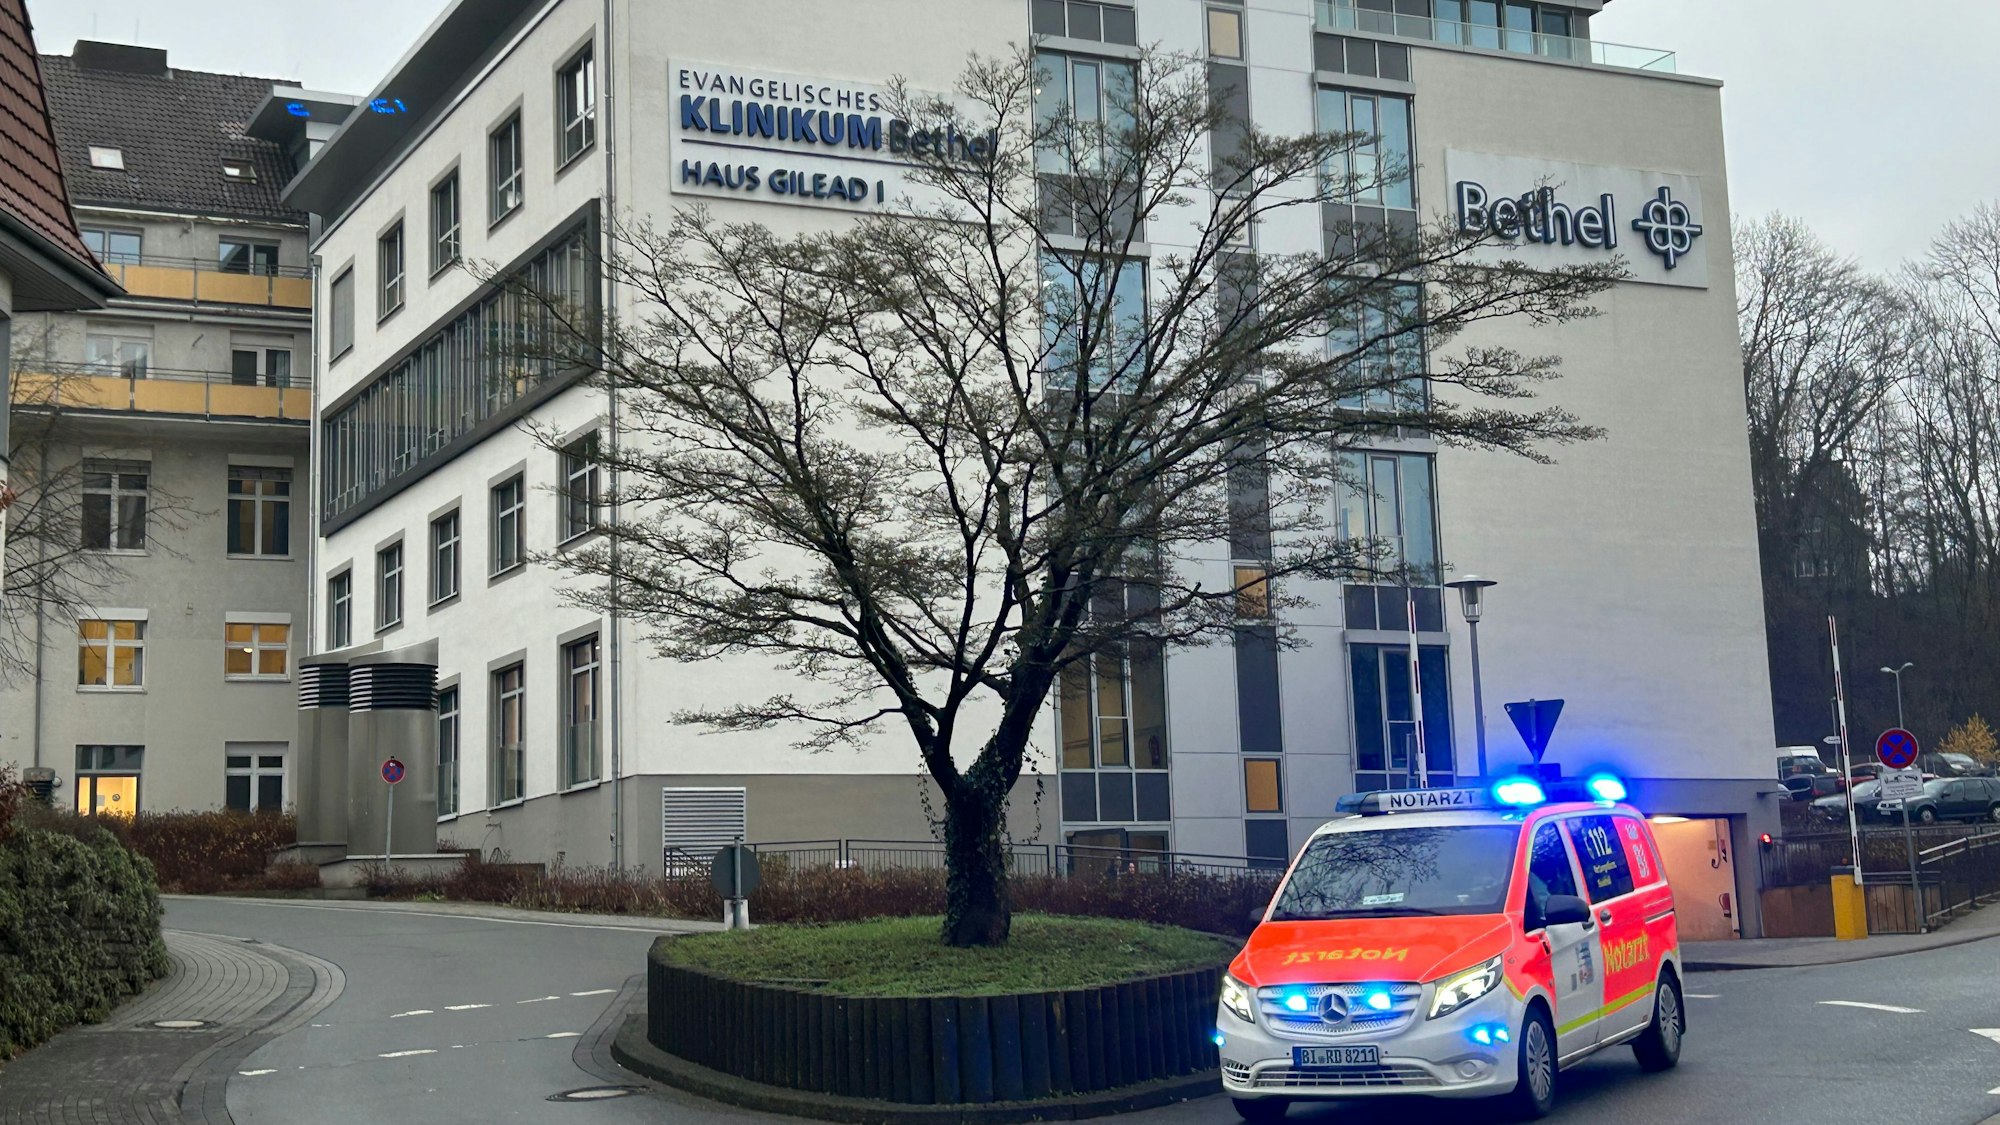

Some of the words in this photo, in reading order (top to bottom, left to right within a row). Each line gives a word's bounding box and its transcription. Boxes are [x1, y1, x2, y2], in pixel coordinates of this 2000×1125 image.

[680, 69, 881, 112] EVANGELISCHES
[680, 94, 883, 152] KLINIKUM
[682, 159, 760, 192] HAUS
[768, 169, 869, 203] GILEAD
[876, 179, 885, 204] I
[1456, 180, 1618, 249] Bethel
[1390, 790, 1476, 808] NOTARZT
[1588, 825, 1613, 857] 112
[1302, 1049, 1318, 1065] BI
[1326, 1049, 1342, 1064] RD
[1345, 1048, 1377, 1064] 8211
